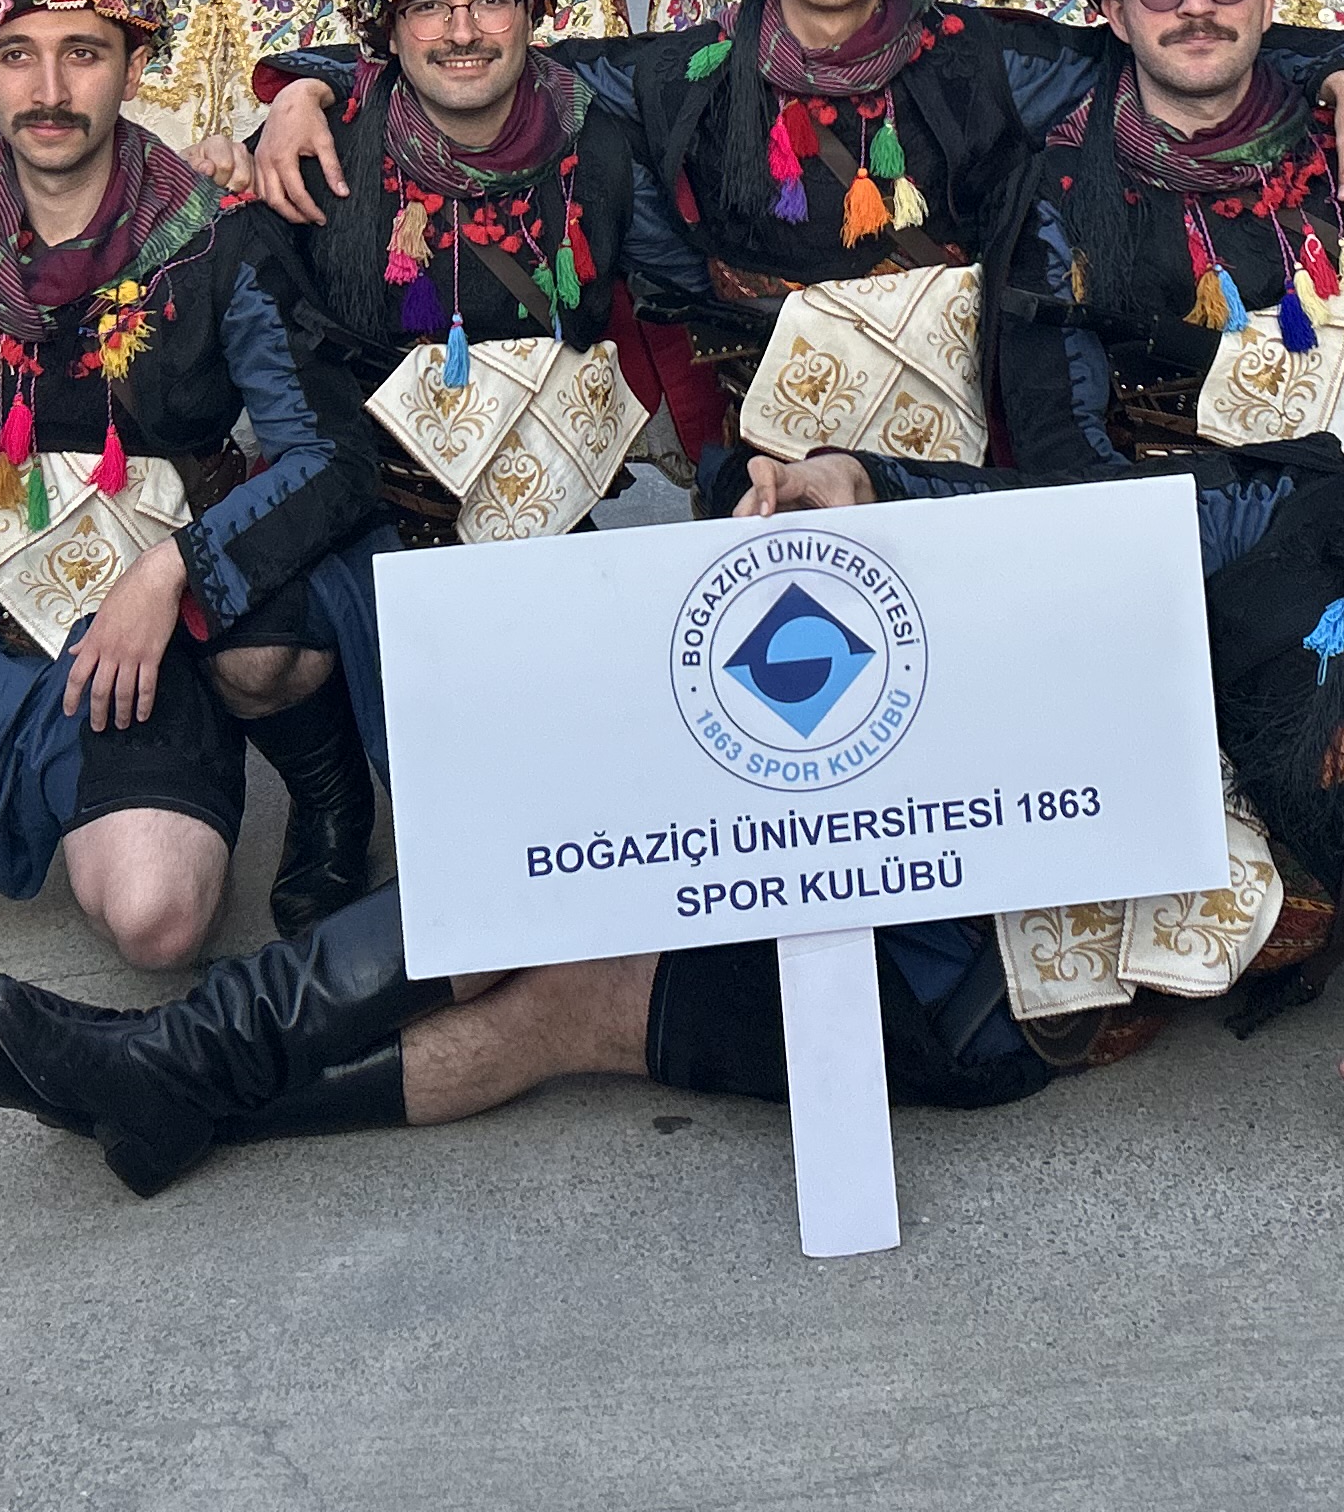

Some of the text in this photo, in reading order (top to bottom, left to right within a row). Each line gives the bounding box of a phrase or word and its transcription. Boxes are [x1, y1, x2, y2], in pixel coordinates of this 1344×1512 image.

[682, 536, 920, 666] BOĞAZİÇİ ÜNİVERSİTESİ
[696, 688, 912, 782] 1863 SPOR KULÜBÜ
[526, 786, 1101, 878] BOĞAZİÇİ ÜNİVERSİTESİ 1863
[675, 850, 964, 917] SPOR KULÜBÜ
